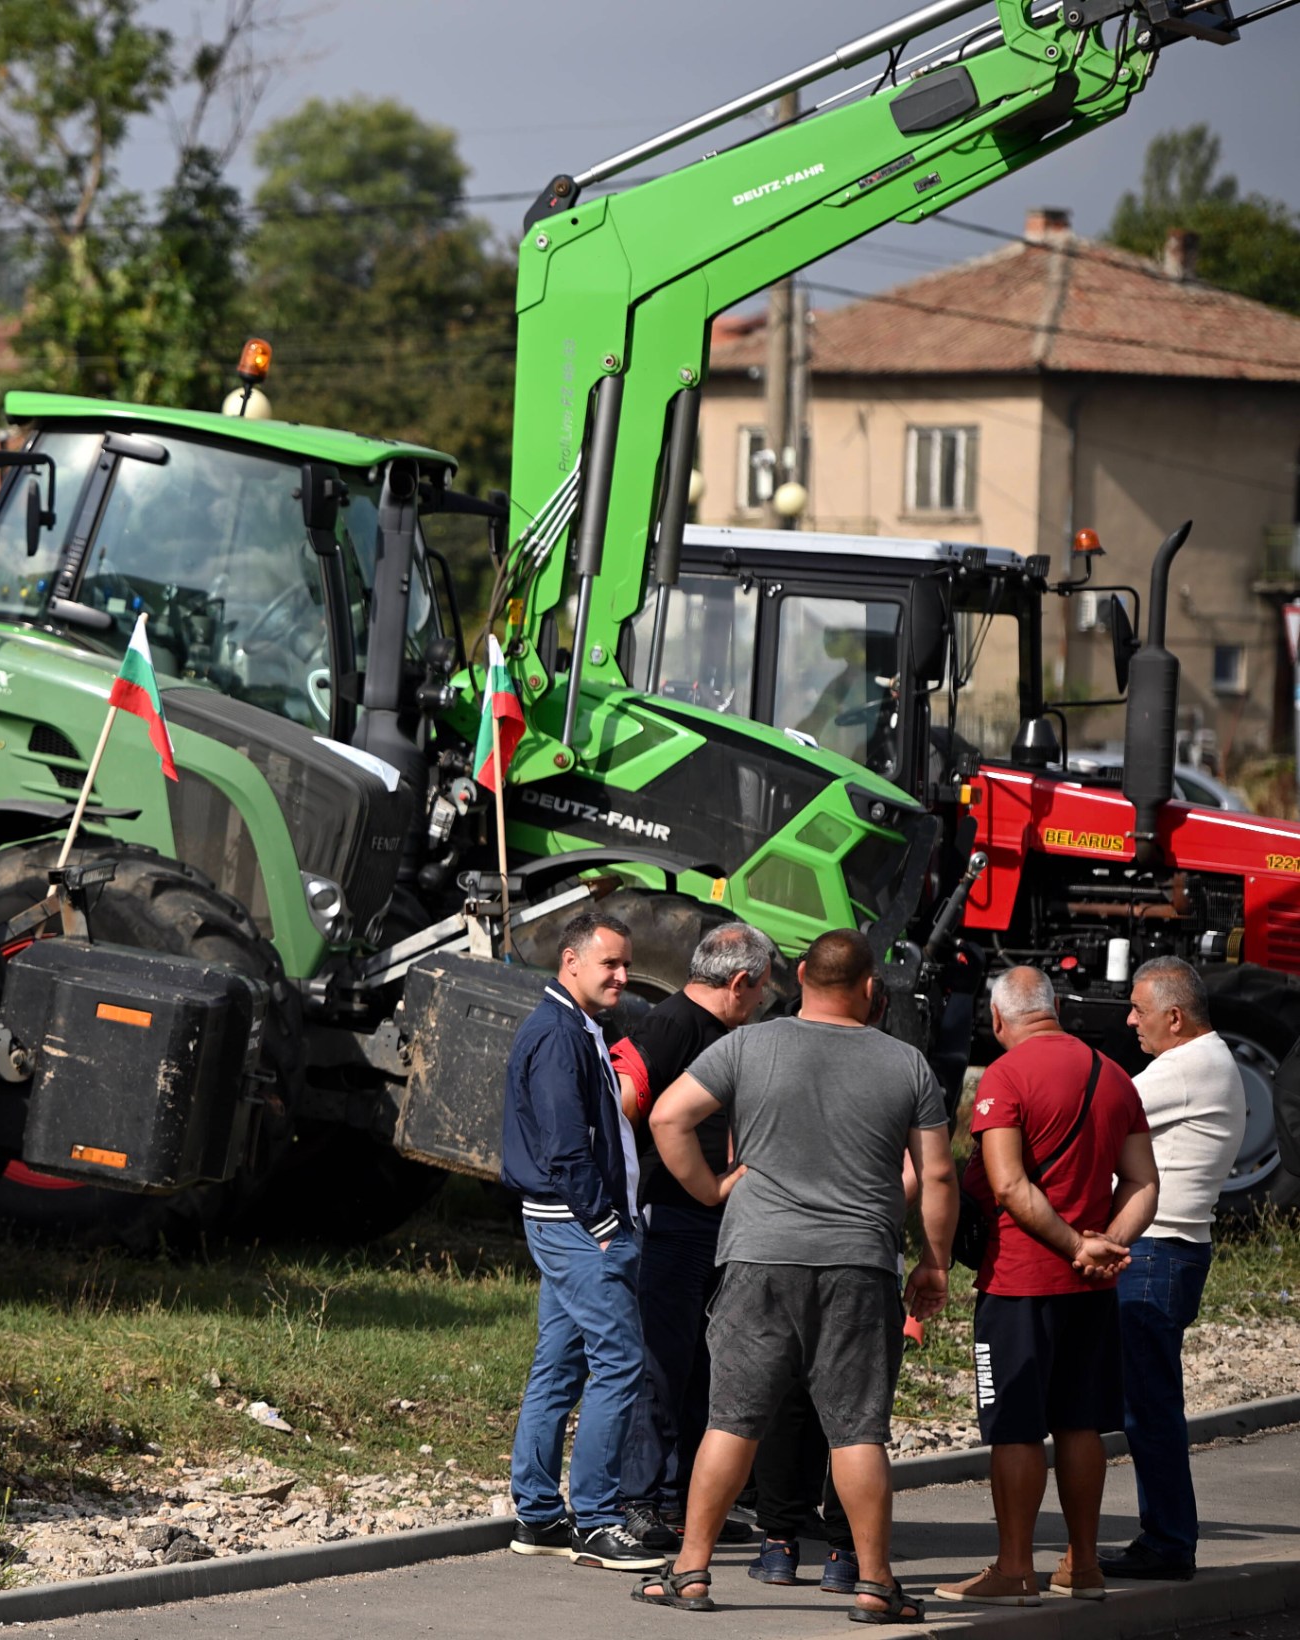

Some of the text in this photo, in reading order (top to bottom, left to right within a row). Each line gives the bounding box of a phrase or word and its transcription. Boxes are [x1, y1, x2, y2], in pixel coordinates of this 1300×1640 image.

[732, 163, 825, 206] DEUTZ-FAHR
[522, 789, 671, 842] DEUTZ-FAHR
[1044, 828, 1124, 851] BELARUS
[975, 1343, 996, 1408] ANIMAL
